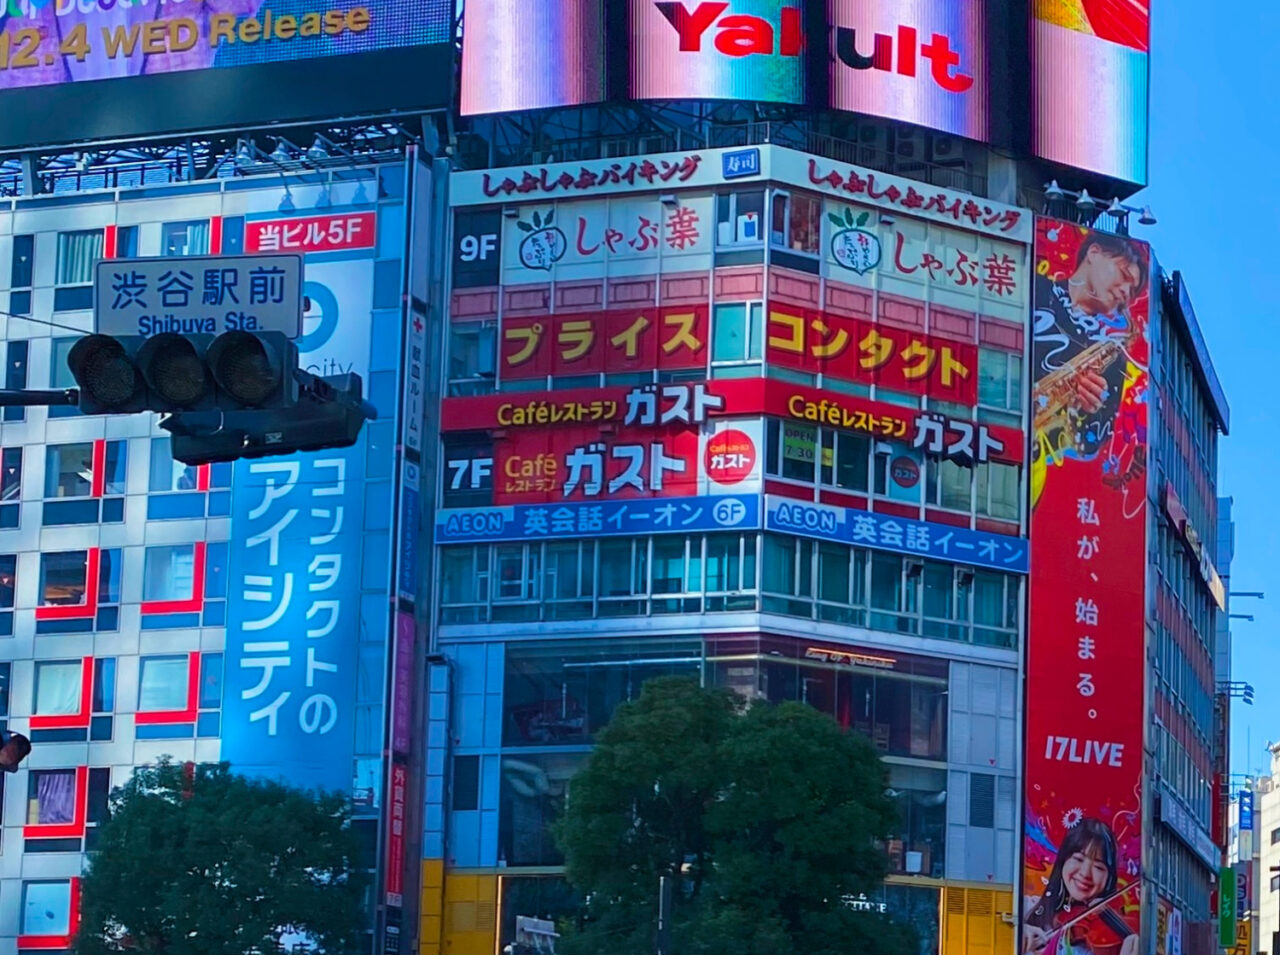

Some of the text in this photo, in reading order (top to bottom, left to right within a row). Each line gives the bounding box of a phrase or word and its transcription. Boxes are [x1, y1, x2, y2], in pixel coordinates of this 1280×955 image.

[101, 18, 199, 60] WED
[210, 5, 371, 48] Release
[483, 155, 702, 198] しゃぶしゃぶバイキング
[726, 151, 759, 175] 寿司
[807, 158, 1020, 232] しゃぶしゃぶバイキング
[258, 217, 362, 252] 当ビル5F
[459, 235, 497, 262] 9F
[576, 207, 701, 255] しゃぶ葉
[893, 232, 1016, 297] しゃぶ葉
[111, 266, 287, 310] 渋谷駅前
[138, 312, 264, 335] Shibuya Sta.
[504, 311, 702, 367] プライス
[769, 311, 970, 388] コンタクト
[497, 383, 726, 426] Caféレストラン ガスト
[788, 394, 1004, 464] Caféレストラン ガスト
[447, 458, 493, 489] 7F
[504, 453, 558, 479] Café
[563, 441, 687, 498] ガスト
[710, 453, 751, 470] ガスト
[443, 500, 743, 536] AEON 英会話イーオン 6F
[775, 501, 1024, 564] AEON 英会話イーオン
[240, 461, 300, 736] アイシティ
[299, 458, 346, 735] コンタクトの
[1075, 497, 1100, 719] 私が、始まる。
[1045, 735, 1125, 768] 17LIVE
